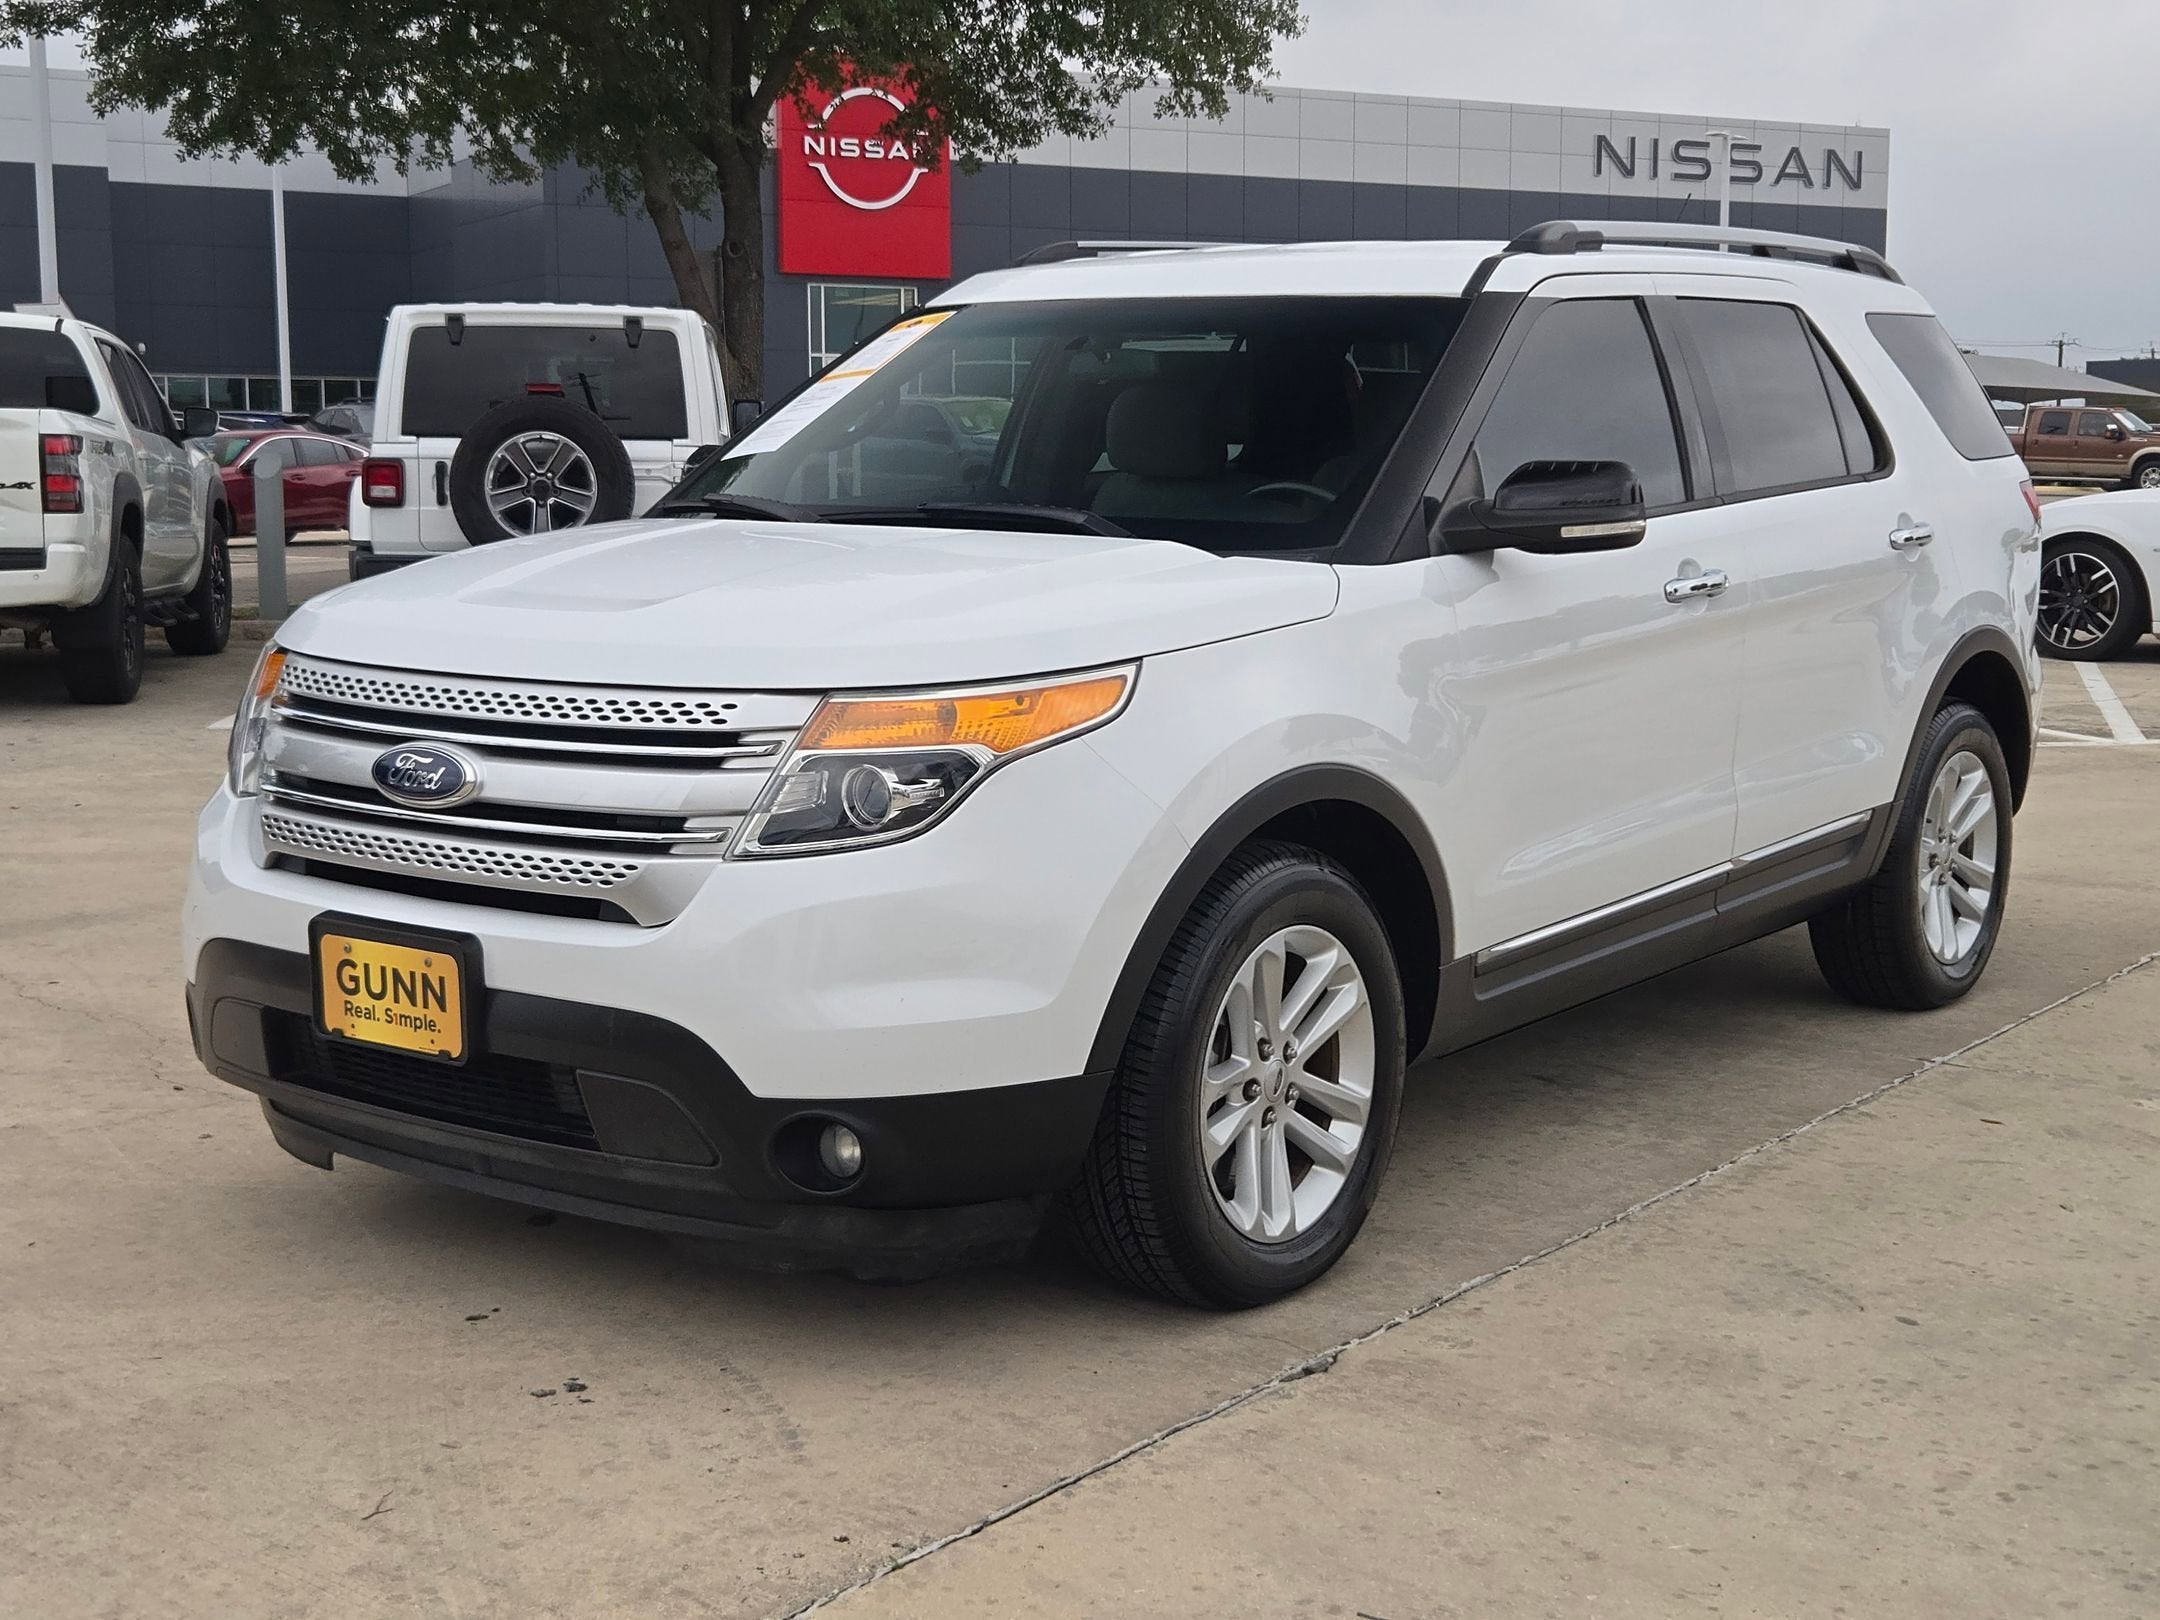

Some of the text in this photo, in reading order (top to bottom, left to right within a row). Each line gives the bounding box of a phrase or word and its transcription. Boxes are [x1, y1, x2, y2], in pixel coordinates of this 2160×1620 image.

[804, 135, 930, 160] NISSA
[1594, 133, 1864, 191] NISSAN
[387, 752, 446, 790] Ford
[336, 958, 447, 1013] GUNN
[344, 1000, 381, 1022] Real.
